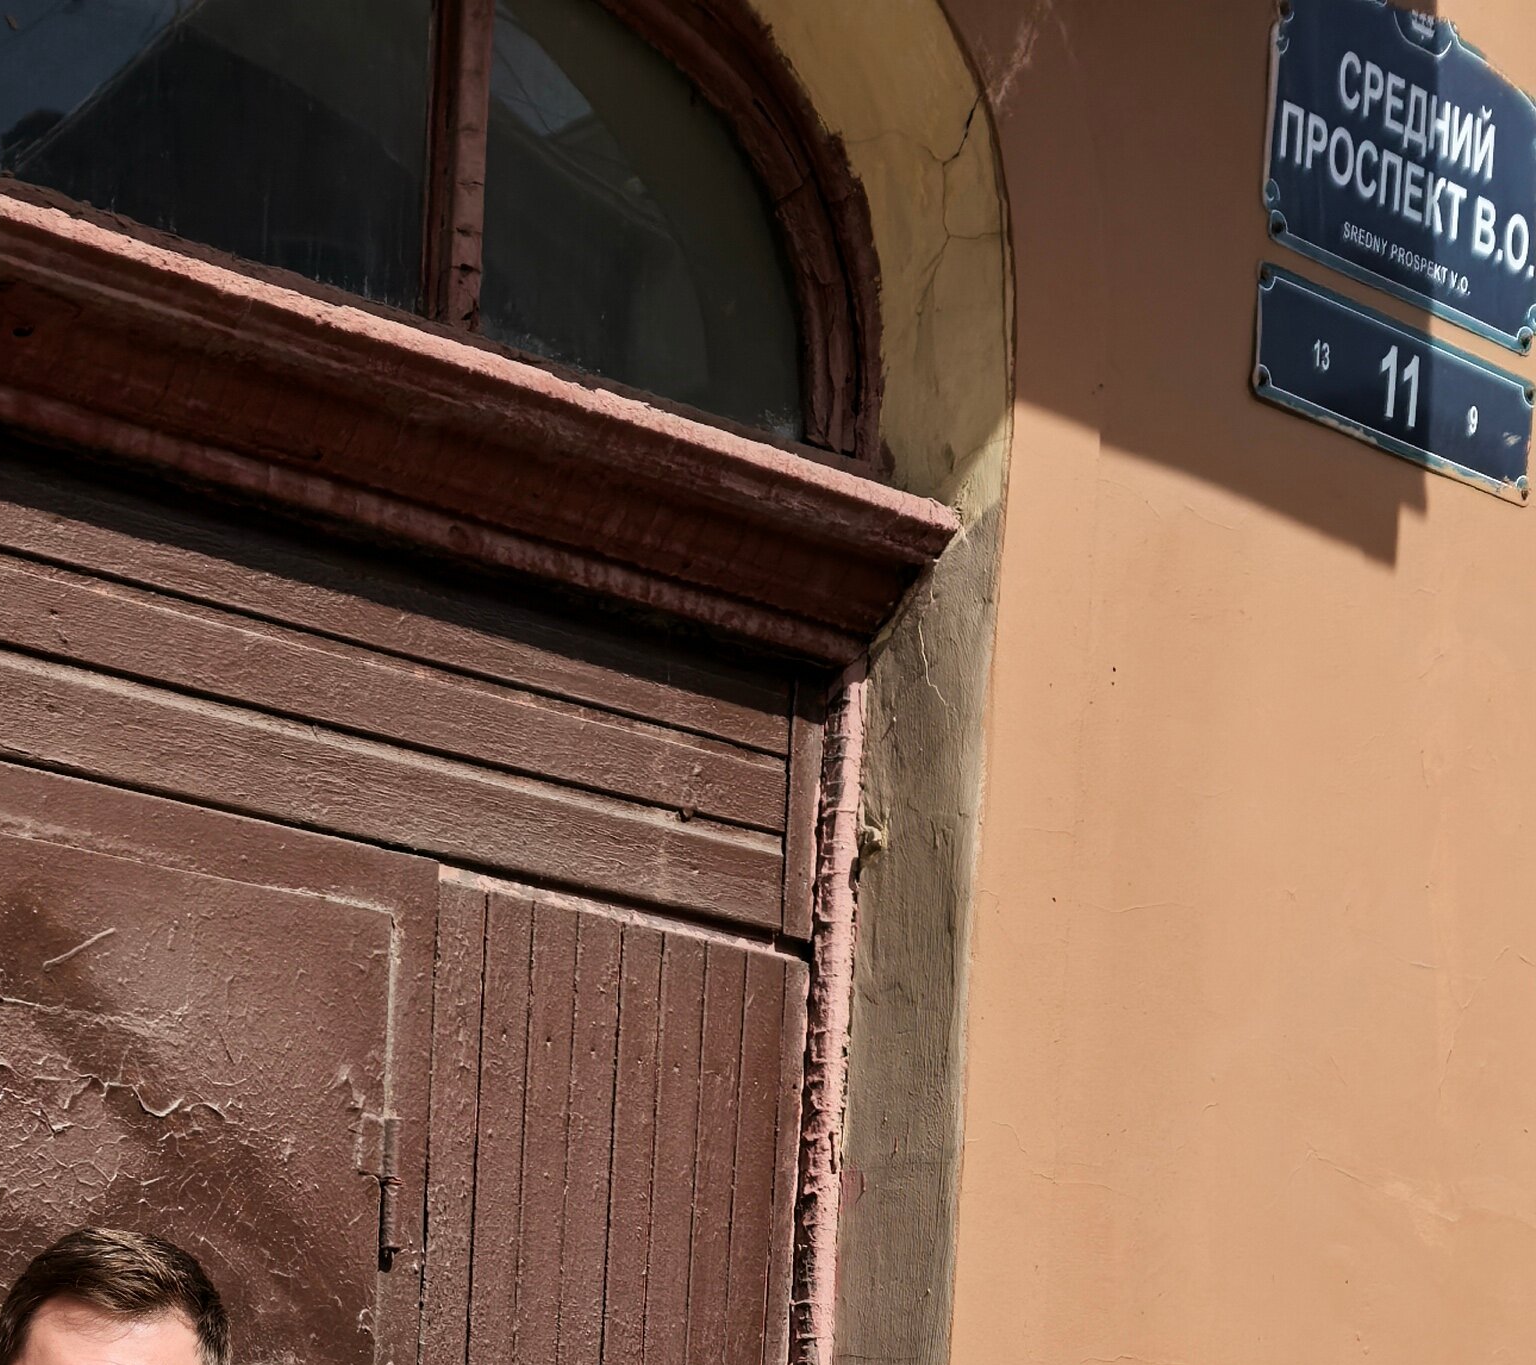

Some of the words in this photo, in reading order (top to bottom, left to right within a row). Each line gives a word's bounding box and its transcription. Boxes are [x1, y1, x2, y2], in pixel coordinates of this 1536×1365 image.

[1339, 51, 1496, 182] СРЕДНИЙ
[1280, 100, 1467, 241] ПРОСПЕКТ
[1472, 195, 1536, 278] В.О.
[1343, 221, 1388, 256] SREDNY
[1391, 244, 1449, 284] PROSPEKT
[1450, 270, 1471, 296] V.O.
[1313, 338, 1331, 371] 13
[1380, 344, 1420, 428] 11
[1466, 405, 1480, 437] 9
